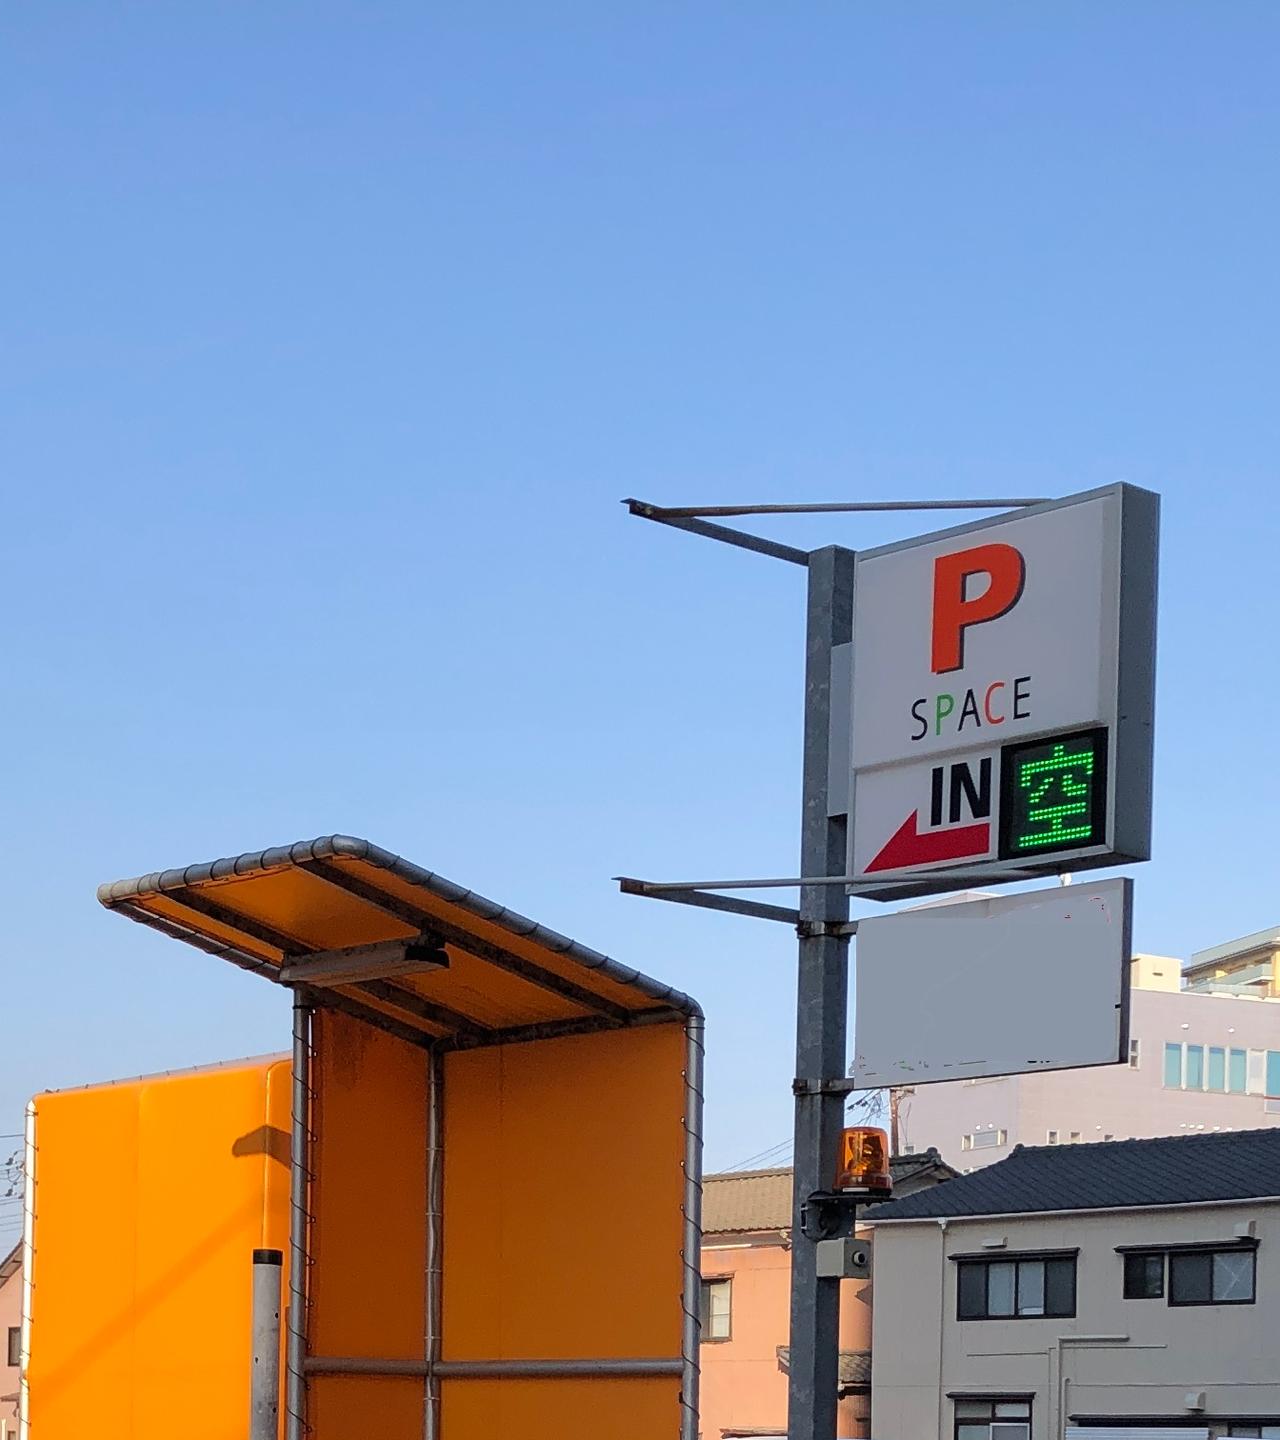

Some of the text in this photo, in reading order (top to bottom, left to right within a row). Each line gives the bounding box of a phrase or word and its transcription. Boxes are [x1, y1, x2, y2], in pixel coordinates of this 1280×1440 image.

[930, 542, 1026, 674] P
[910, 676, 1032, 741] SPACE
[930, 757, 992, 827] IN
[1019, 745, 1094, 848] 空
